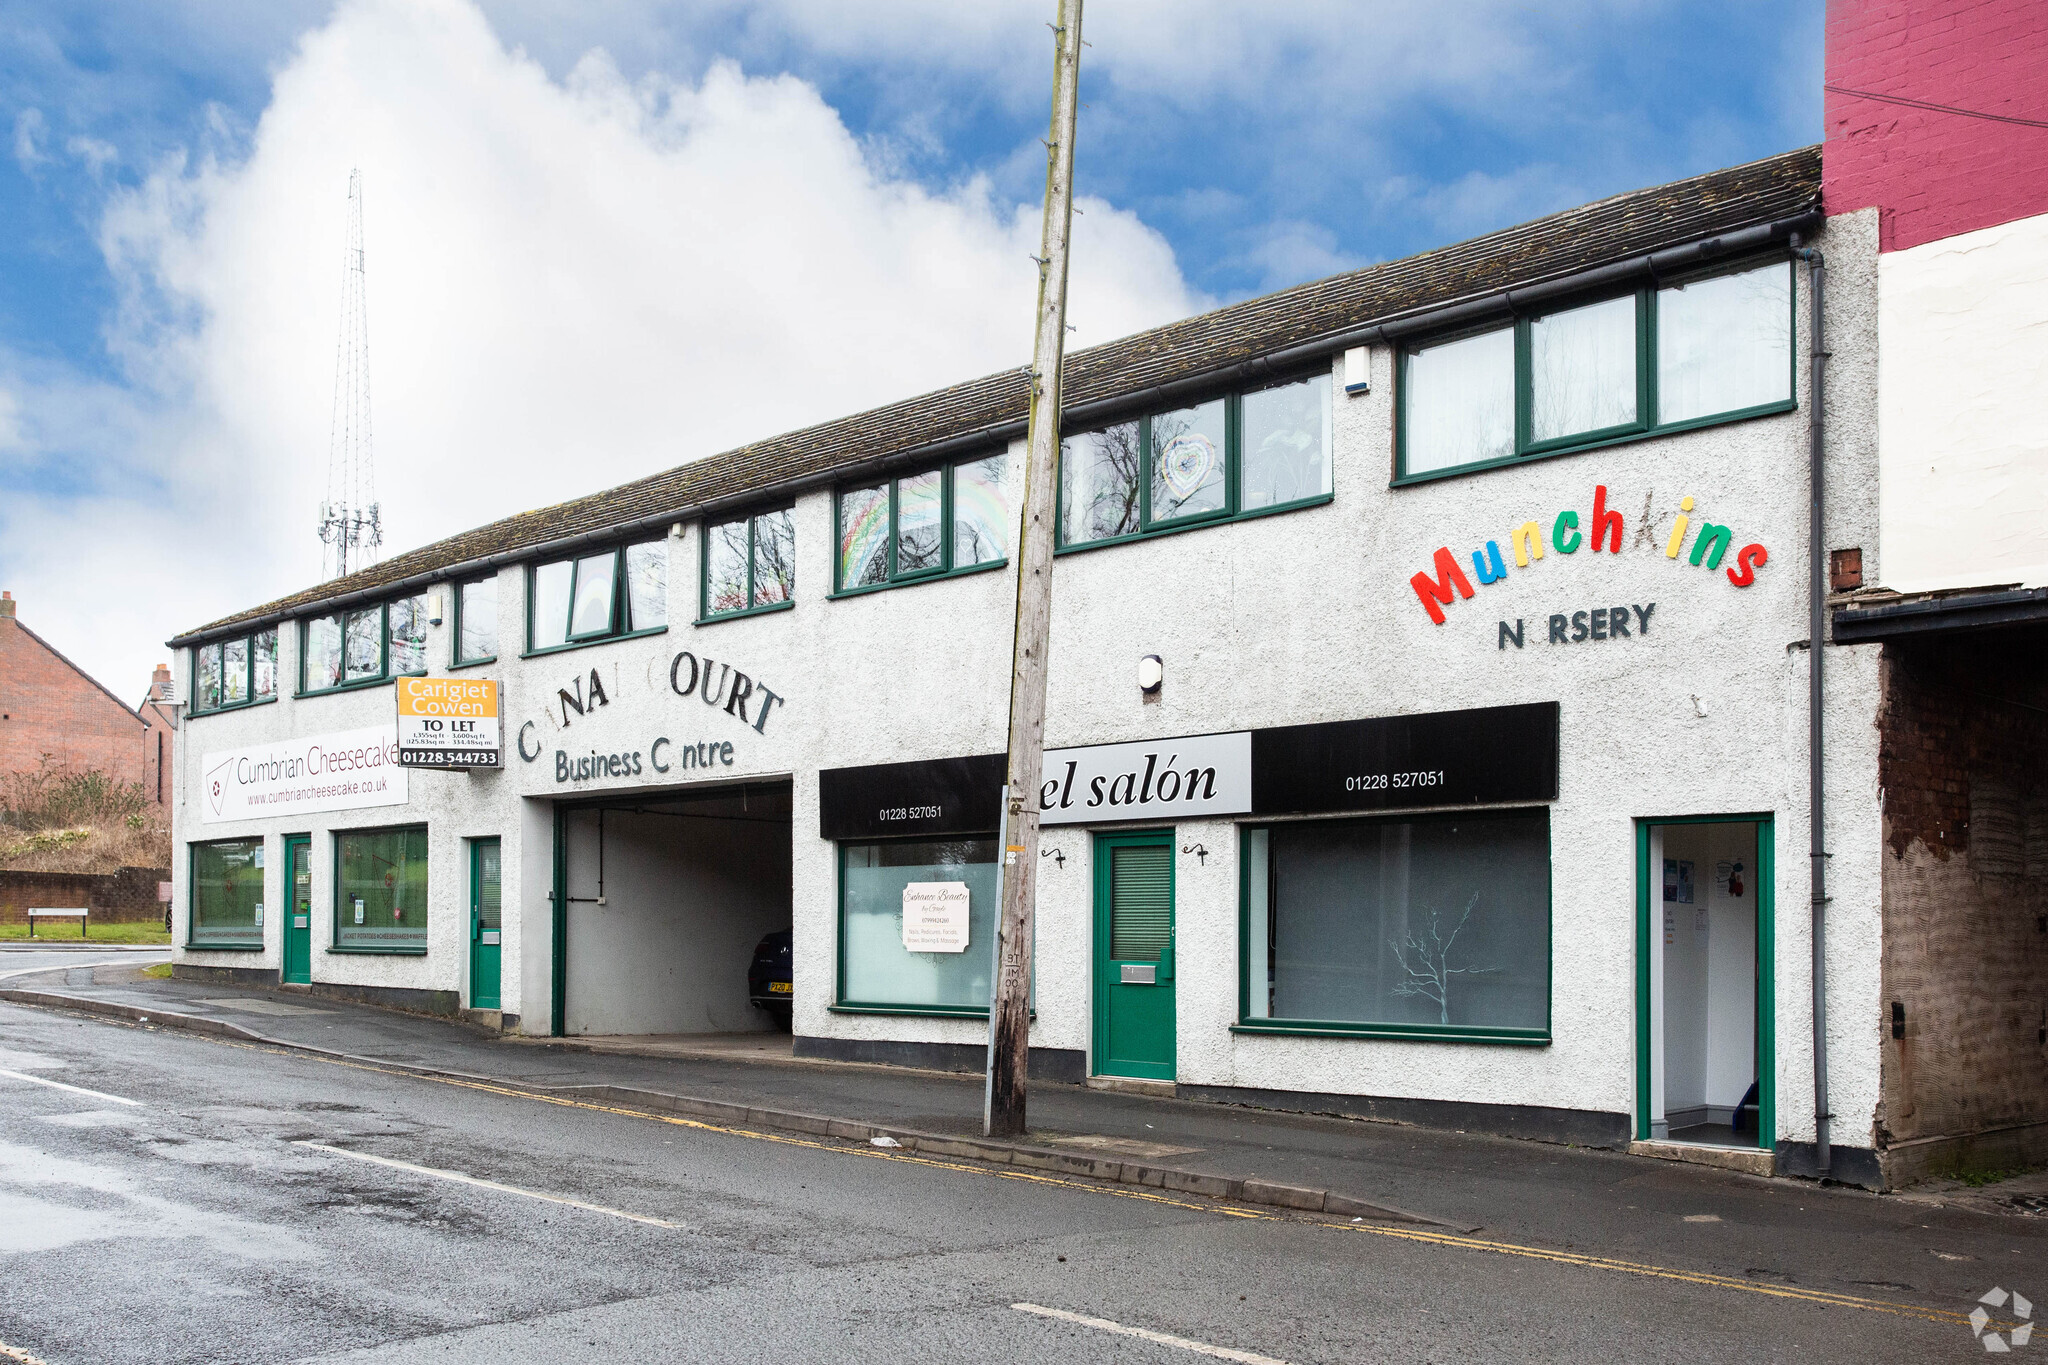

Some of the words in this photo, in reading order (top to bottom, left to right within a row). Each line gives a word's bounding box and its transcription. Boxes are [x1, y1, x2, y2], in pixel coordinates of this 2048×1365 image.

[1498, 602, 1656, 651] NRSERY
[407, 680, 489, 702] Carigiet
[412, 697, 484, 715] Cowen
[422, 720, 444, 731] TO
[451, 721, 476, 732] LET
[236, 752, 304, 785] Cumbrian
[306, 736, 399, 776] Cheesecake
[402, 751, 444, 763] 01228
[446, 752, 497, 764] 544733
[555, 750, 642, 783] Business
[651, 737, 735, 773] Cntre
[247, 776, 388, 806] www.cumbriancheesecake.co.uk
[1038, 760, 1078, 811] el
[1086, 753, 1218, 808] salón
[1345, 774, 1389, 792] 01228
[1392, 770, 1444, 788] 527051
[879, 808, 907, 821] 01228
[909, 805, 942, 819] 527051
[938, 888, 968, 904] Beauty
